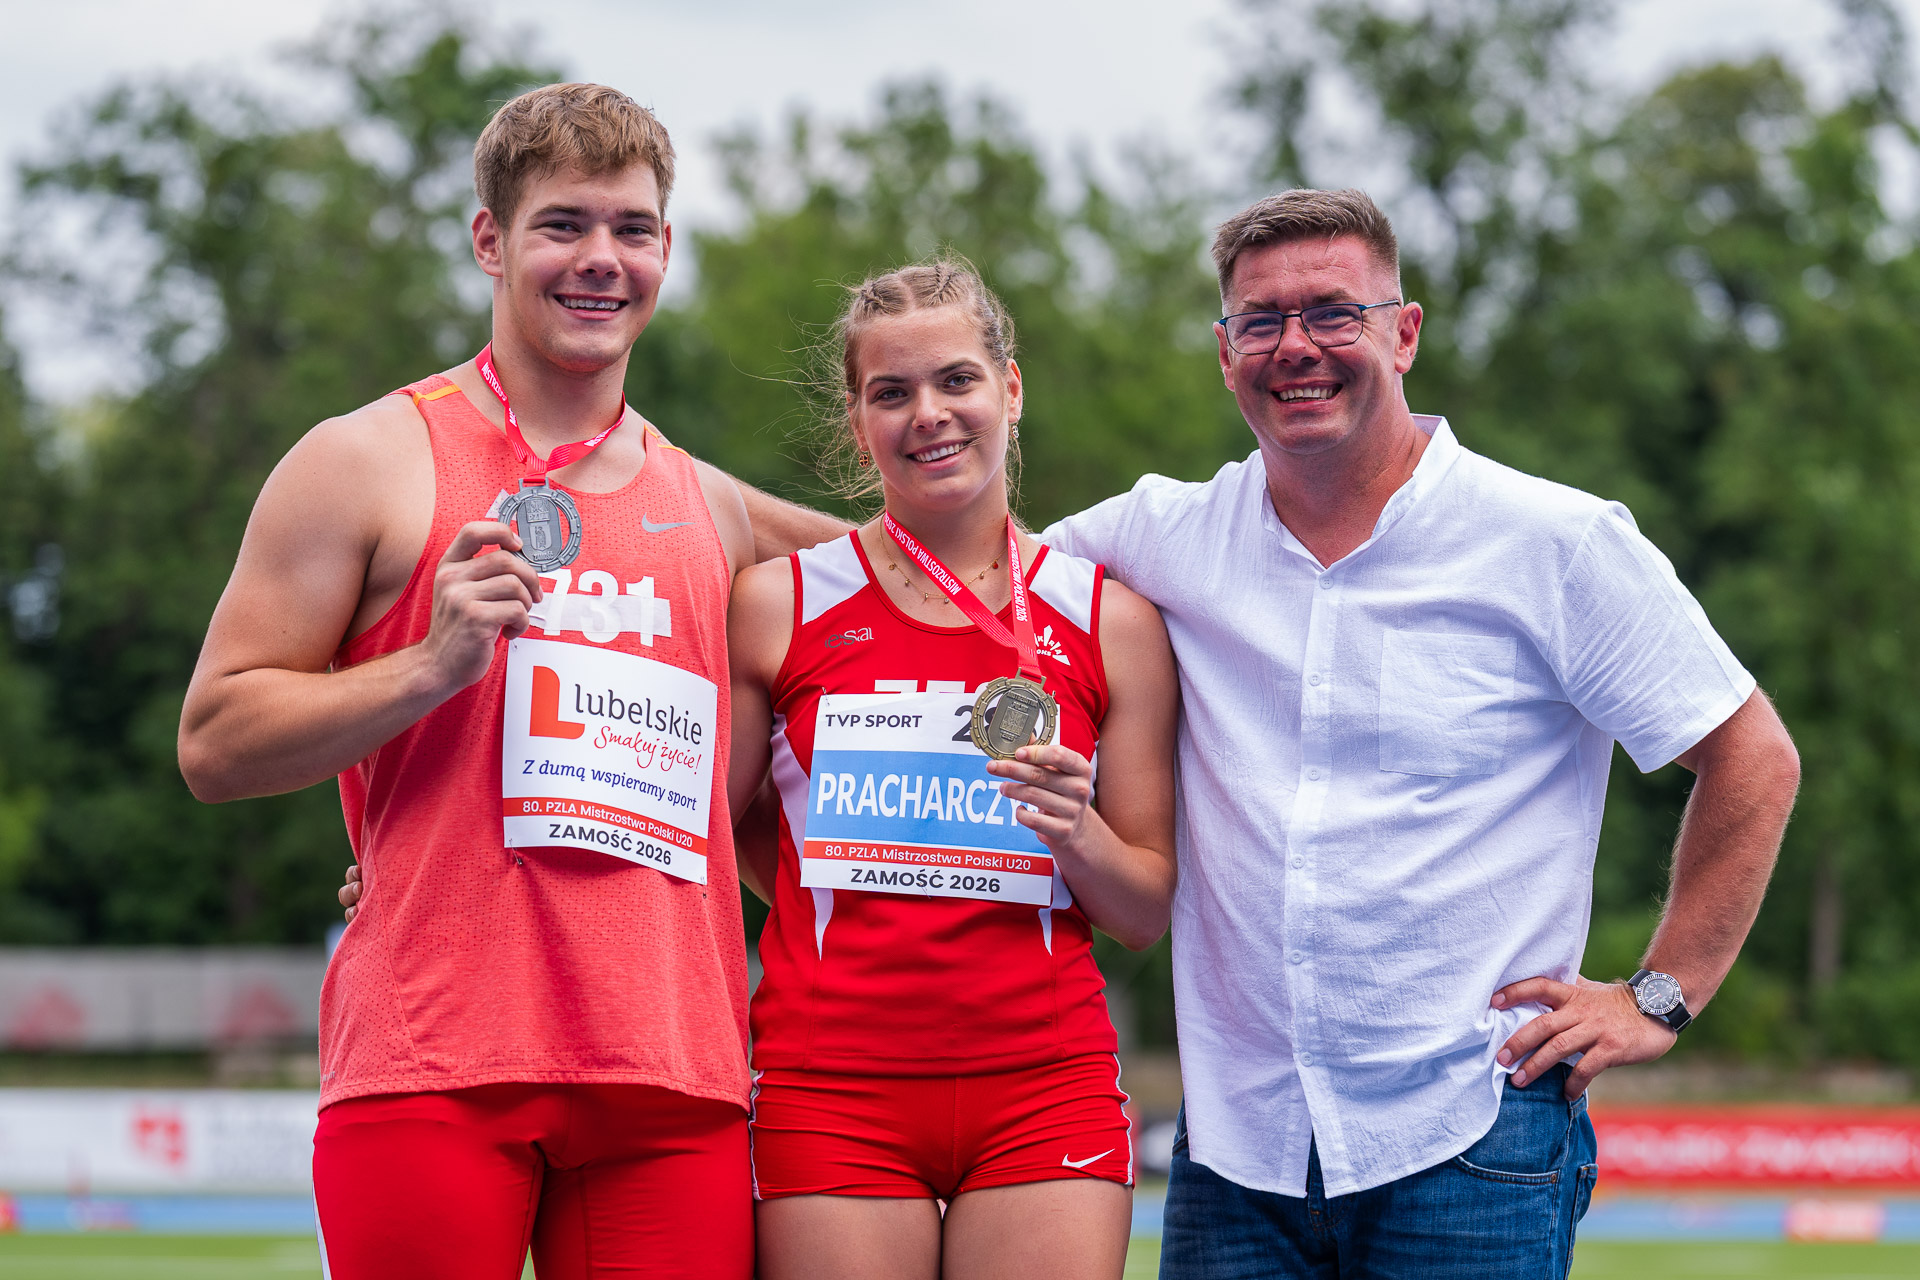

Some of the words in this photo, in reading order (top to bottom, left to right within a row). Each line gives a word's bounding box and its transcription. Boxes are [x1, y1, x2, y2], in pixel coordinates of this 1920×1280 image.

[895, 527, 919, 555] POLSKI
[917, 548, 962, 595] MISTRZOSTWA
[575, 684, 702, 745] lubelskie
[826, 714, 861, 728] TVP
[865, 715, 923, 728] SPORT
[594, 725, 656, 769] Smakuj
[660, 741, 702, 775] życie!
[523, 760, 535, 775] Z
[539, 760, 585, 781] dumą
[591, 769, 666, 803] wspieramy
[668, 790, 698, 811] sport
[523, 801, 543, 813] 80.
[546, 802, 577, 815] PZLA
[580, 805, 646, 830] Mistrzostwa
[648, 821, 675, 841] Polski
[676, 834, 693, 848] U20
[549, 823, 633, 852] ZAMOŚĆ
[636, 841, 672, 866] 2026
[825, 845, 845, 857] 80.
[849, 846, 879, 859] PZLA
[882, 849, 961, 865] Mistrzostwa
[965, 853, 1003, 869] Polski
[1006, 857, 1031, 871] U20
[850, 868, 944, 889] ZAMOŚĆ
[949, 874, 1001, 893] 2026
